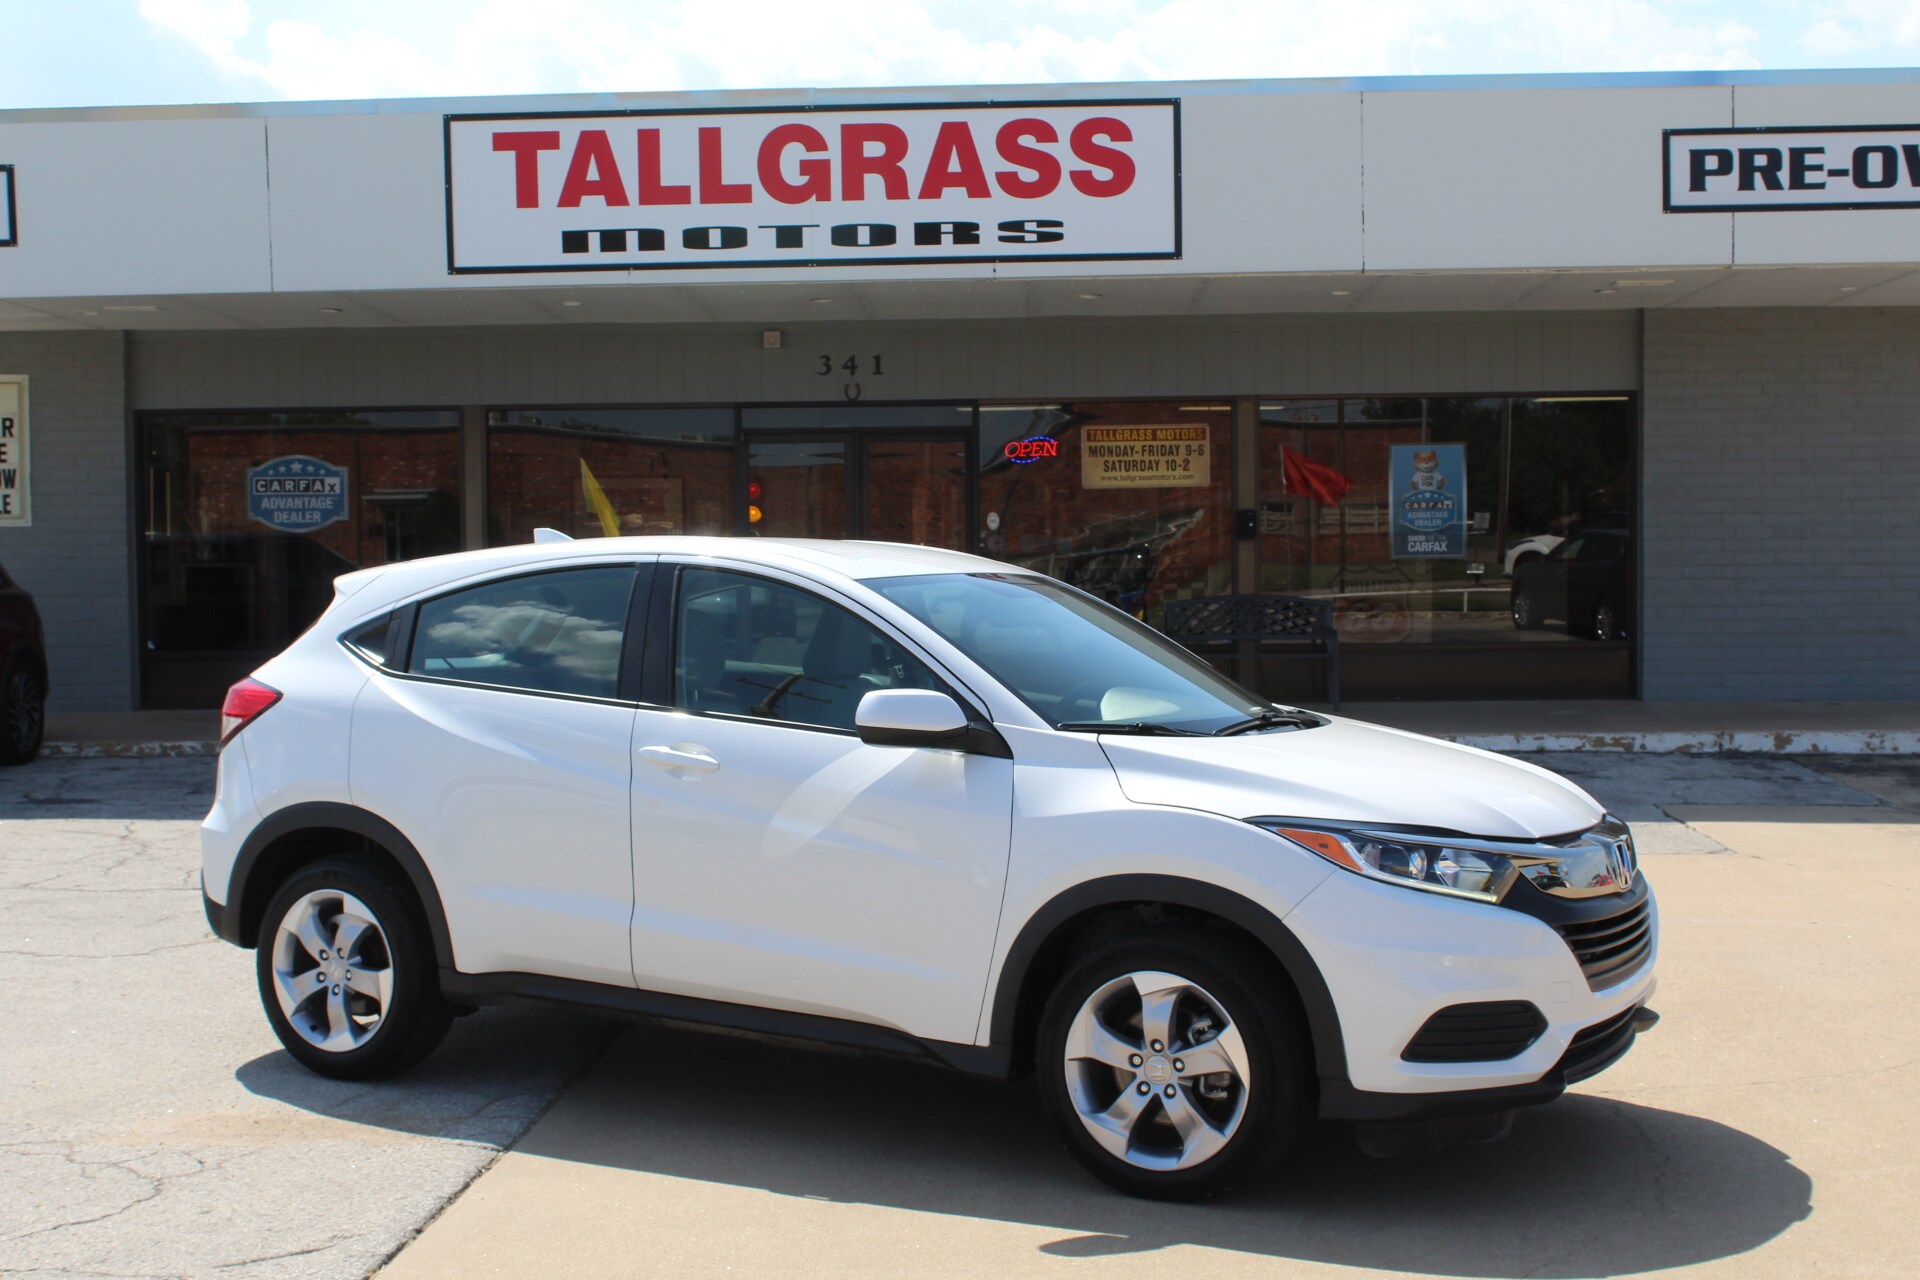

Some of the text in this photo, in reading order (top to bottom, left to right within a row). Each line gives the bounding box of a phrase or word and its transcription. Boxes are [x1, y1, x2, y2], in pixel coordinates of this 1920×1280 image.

[491, 116, 1137, 209] TALLGRASS
[815, 354, 885, 376] 341
[1089, 428, 1205, 441] TALLGRASS MOTORS
[1004, 440, 1059, 459] OPEN
[1185, 444, 1205, 457] 9-6
[1103, 458, 1191, 473] SATURDAY 10-2
[256, 480, 337, 493] CARFAX
[261, 497, 334, 510] ADVANTAGE
[273, 511, 321, 523] DEALER
[1408, 511, 1449, 519] ADVANTAGE
[1414, 519, 1442, 527] DEALER
[1408, 541, 1448, 552] CARFAX
